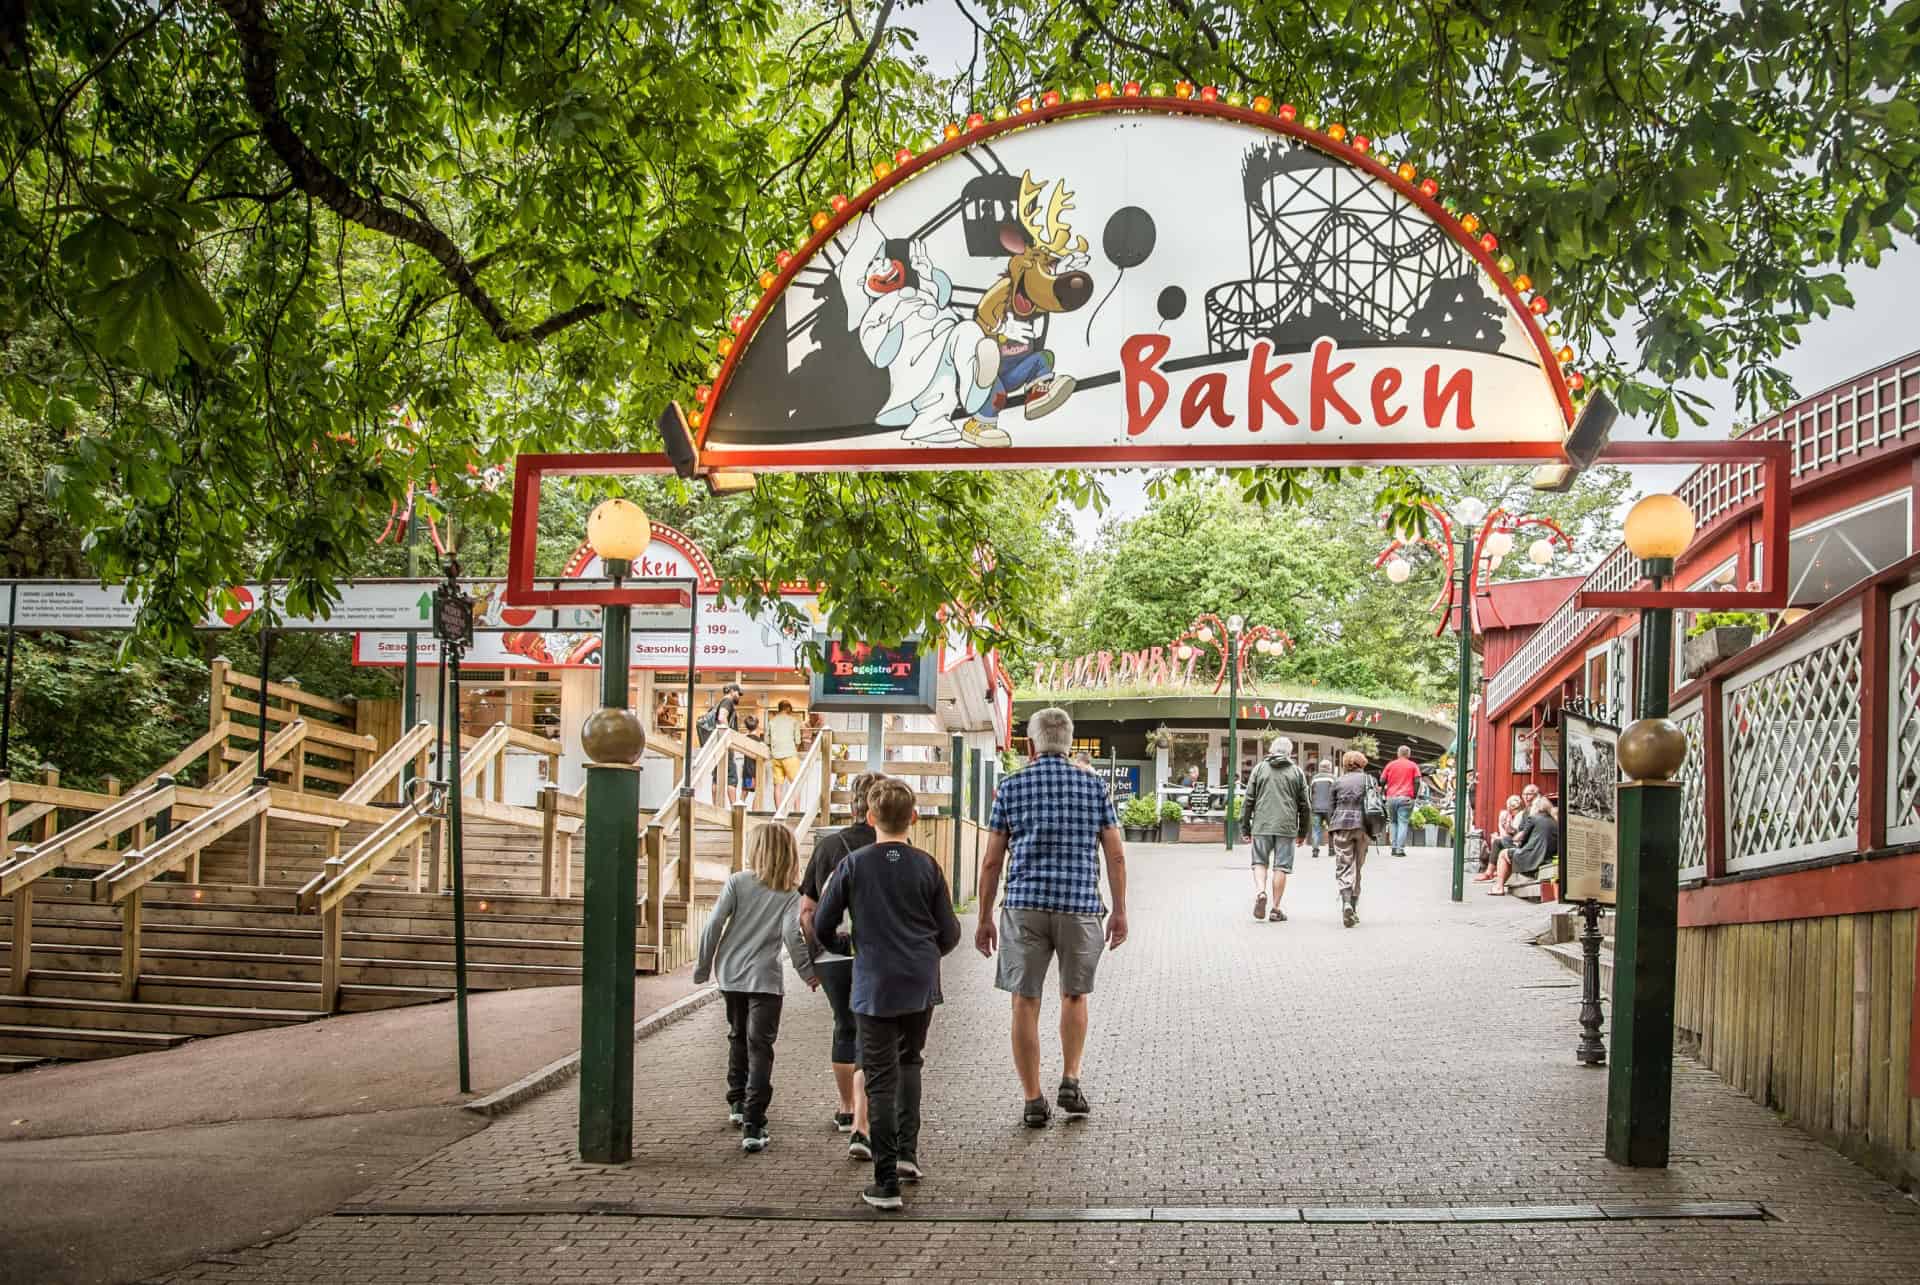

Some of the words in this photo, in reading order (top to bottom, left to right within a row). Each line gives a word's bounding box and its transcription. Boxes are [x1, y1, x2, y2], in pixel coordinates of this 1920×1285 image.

[1120, 334, 1475, 436] Bakken
[707, 624, 727, 634] 199
[378, 642, 436, 651] Sæsokort
[703, 645, 726, 654] 899
[1273, 702, 1310, 717] CAFE
